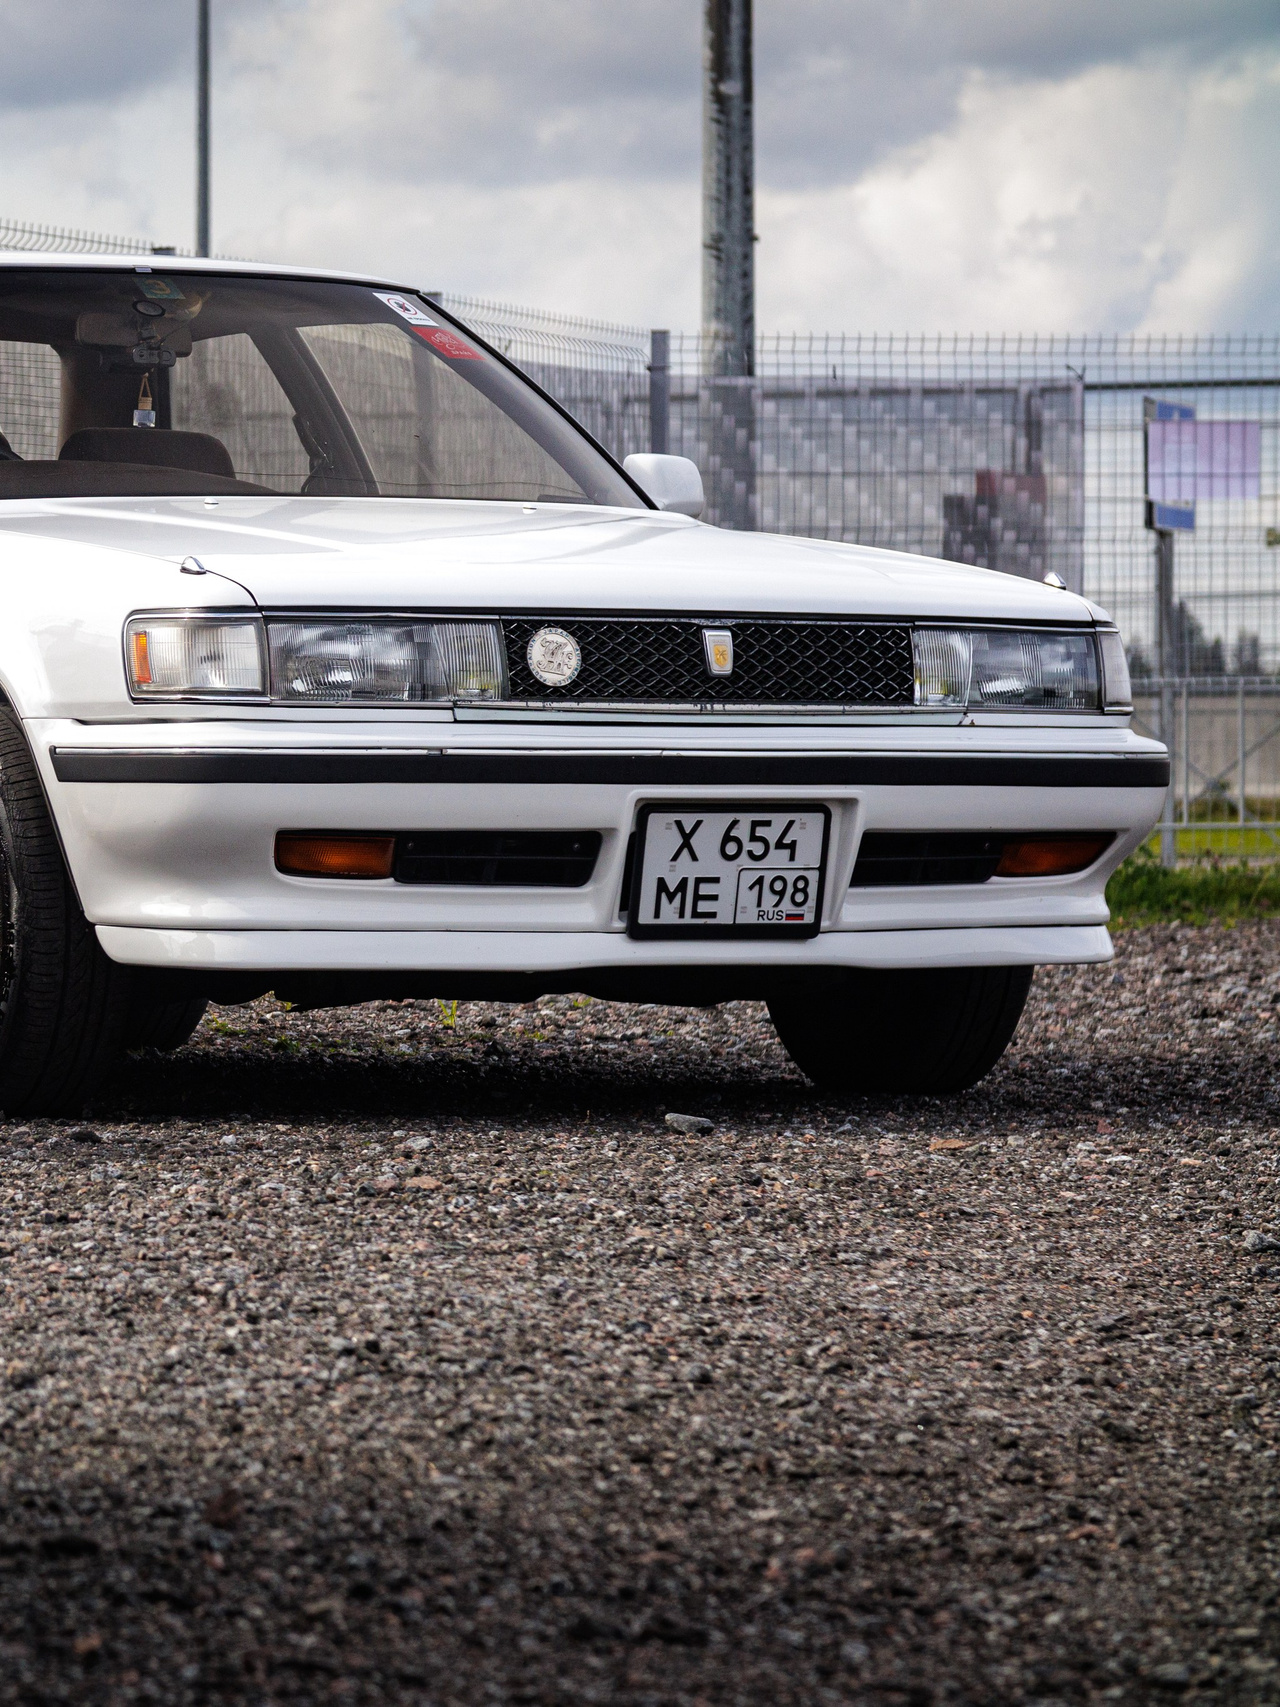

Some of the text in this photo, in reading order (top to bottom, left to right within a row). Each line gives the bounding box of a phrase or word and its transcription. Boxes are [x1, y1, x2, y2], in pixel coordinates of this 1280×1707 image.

[669, 819, 798, 862] X 654
[653, 876, 720, 919] ME
[747, 874, 810, 909] 198
[757, 909, 785, 921] RUS
